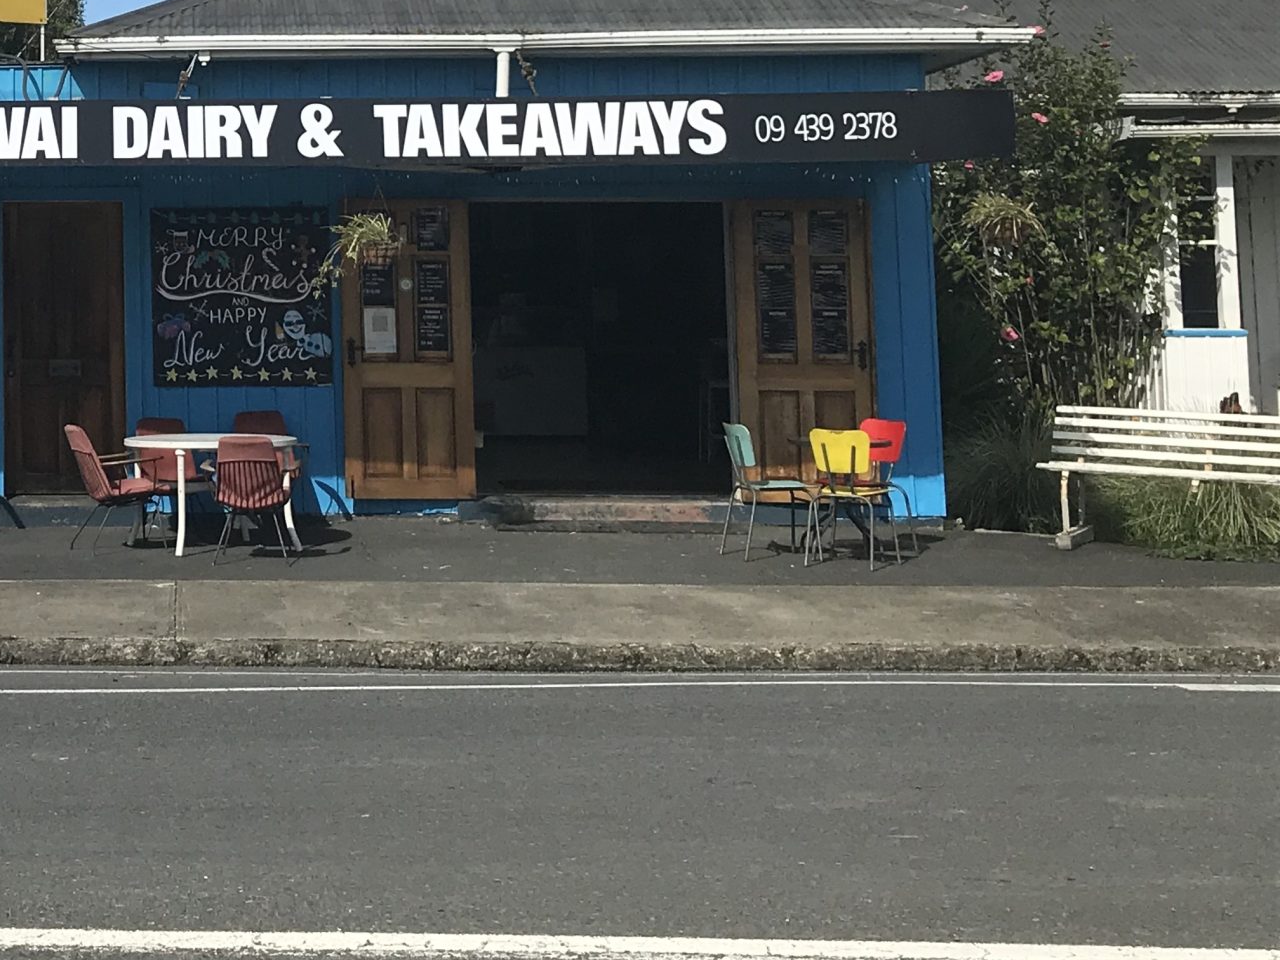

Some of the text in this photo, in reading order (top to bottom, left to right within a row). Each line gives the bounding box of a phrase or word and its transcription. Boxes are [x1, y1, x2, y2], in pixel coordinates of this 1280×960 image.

[113, 105, 278, 159] DAIRY
[297, 103, 344, 158] &
[373, 99, 727, 157] TAKEAWAYS
[755, 115, 785, 143] 09
[794, 113, 834, 141] 439
[843, 112, 898, 140] 2378
[196, 226, 283, 250] MERRY
[162, 252, 312, 293] Christmas
[210, 307, 267, 324] HAPPY
[231, 296, 249, 306] AND
[163, 325, 315, 368] New Year
